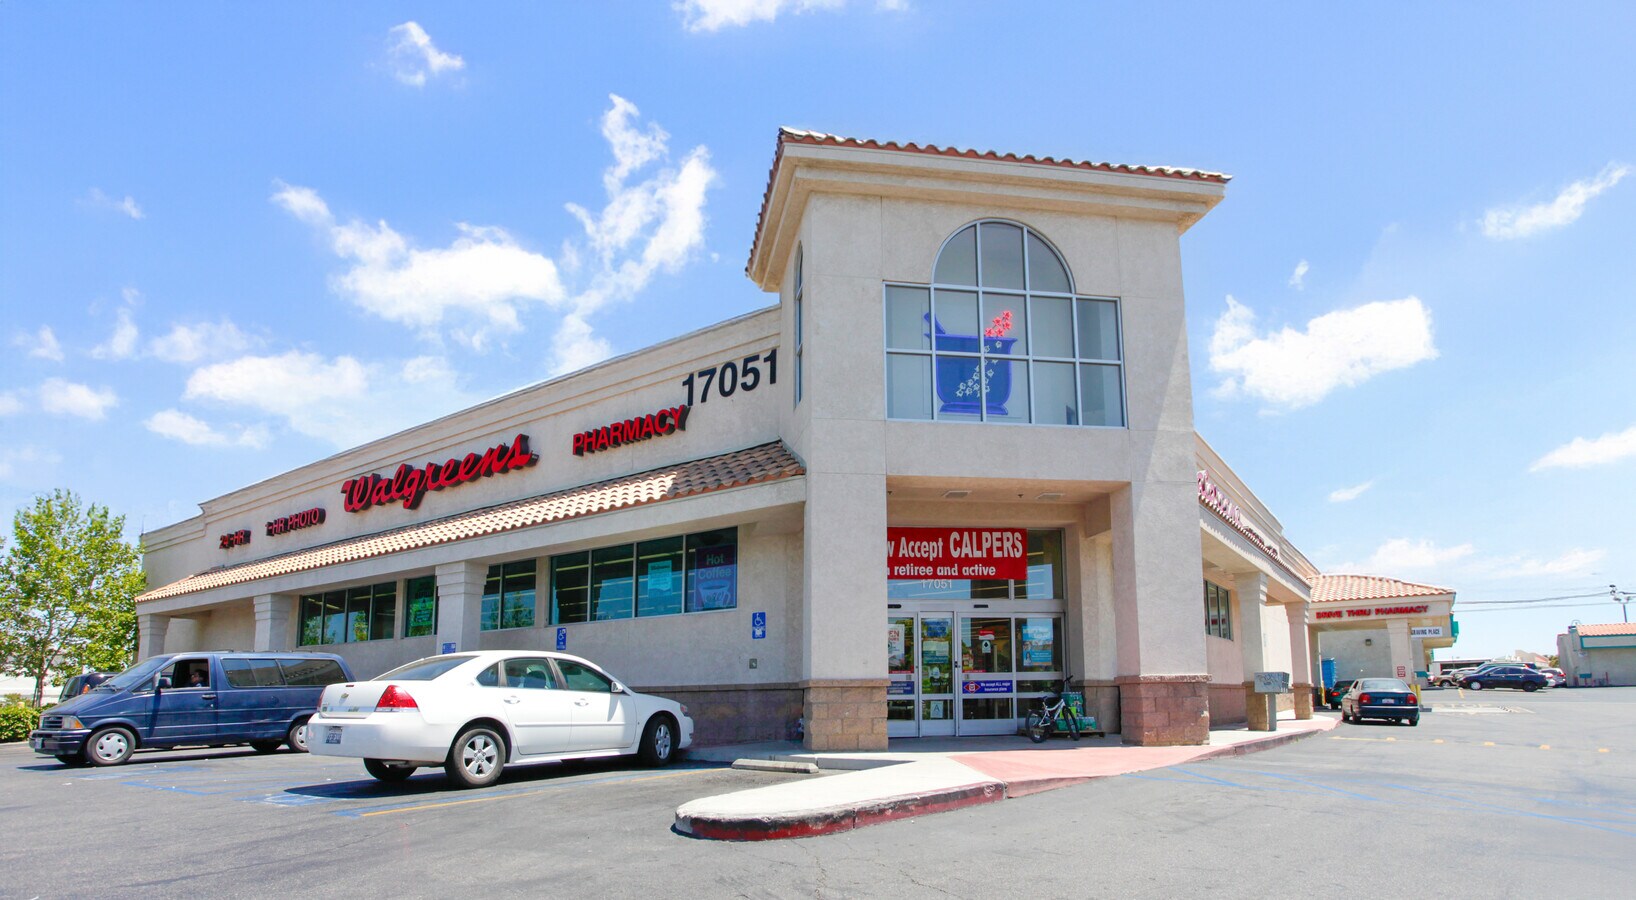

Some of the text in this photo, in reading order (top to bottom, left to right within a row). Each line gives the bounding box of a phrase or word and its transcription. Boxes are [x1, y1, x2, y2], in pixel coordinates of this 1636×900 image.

[682, 348, 777, 406] 17051
[573, 404, 686, 456] PHARMACY
[340, 433, 535, 513] Walgreens
[287, 507, 321, 531] PHOTO
[219, 529, 247, 549] 24-HR
[898, 537, 943, 561] Accept
[949, 531, 1023, 558] CALPERS
[706, 554, 724, 565] Hot
[894, 563, 933, 576] retiree
[936, 563, 958, 576] and
[962, 564, 996, 576] active
[698, 567, 731, 579] Coffee
[921, 579, 952, 589] 17051
[1316, 605, 1429, 619] DRIVE THRU PHARMACY
